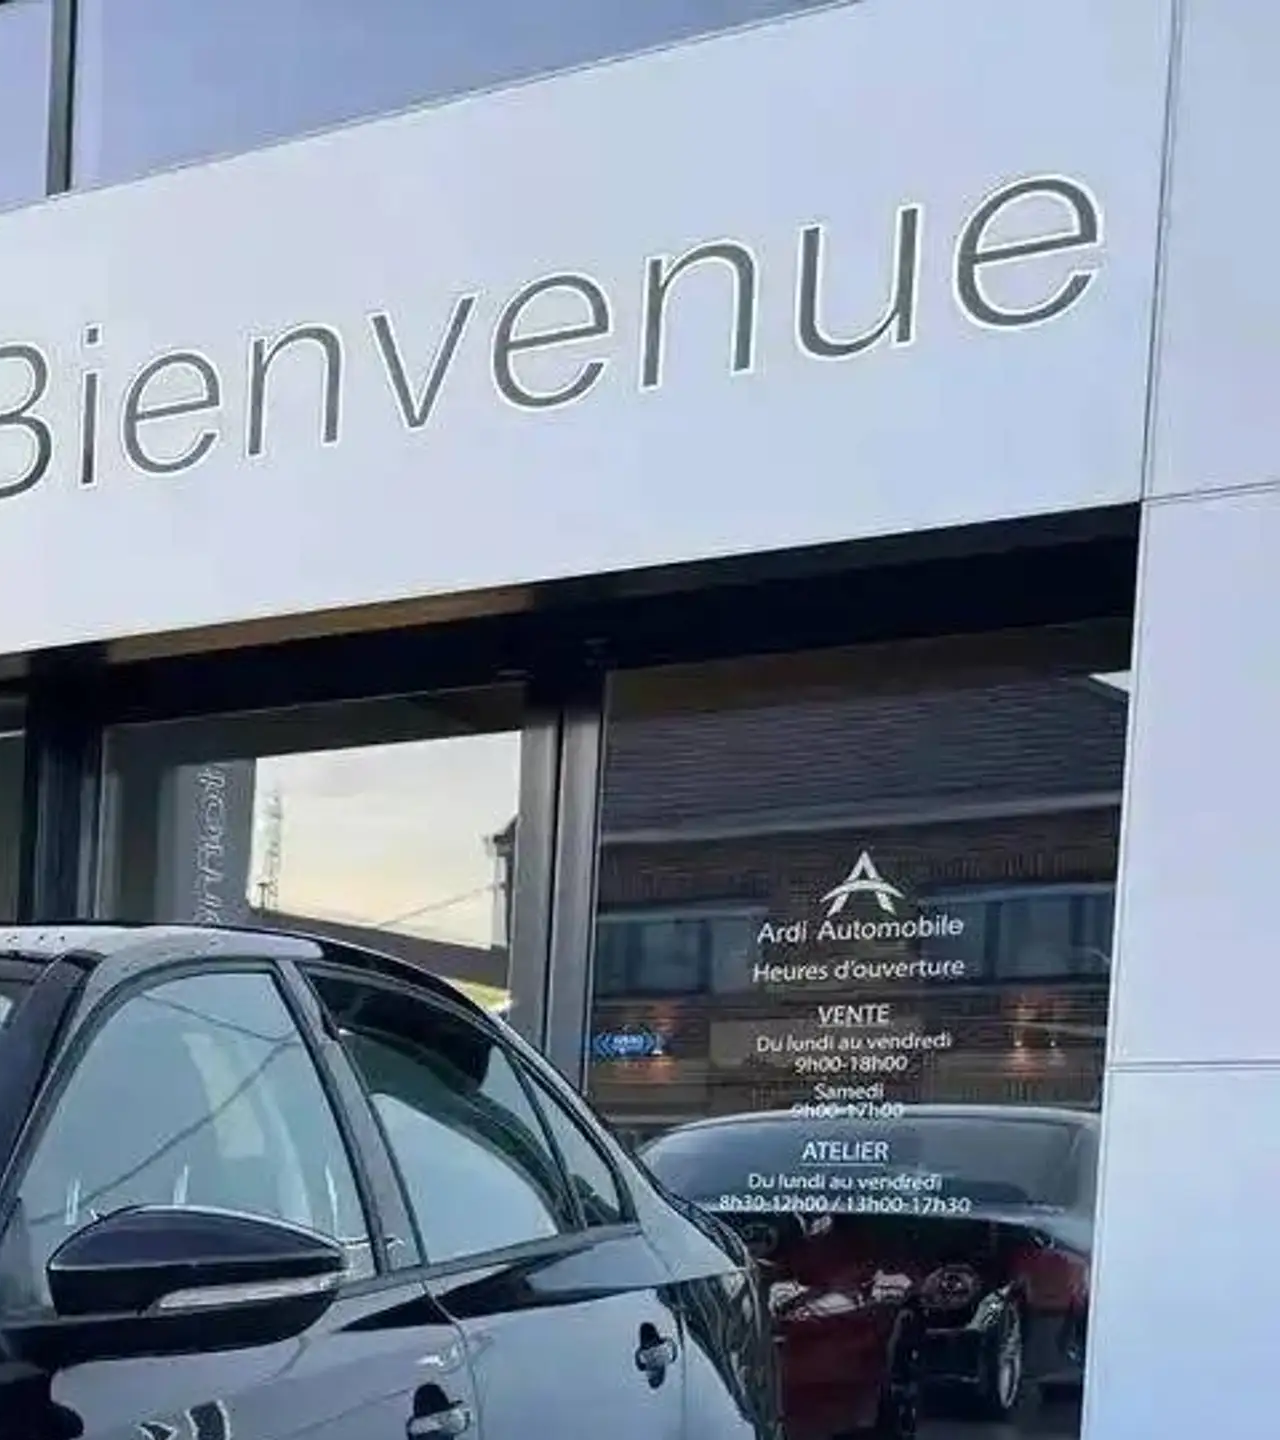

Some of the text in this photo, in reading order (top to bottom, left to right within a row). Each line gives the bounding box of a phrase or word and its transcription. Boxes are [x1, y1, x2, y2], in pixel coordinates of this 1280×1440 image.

[757, 914, 965, 943] Ardi Automobile
[752, 958, 966, 982] Heures d'ouverture
[817, 1004, 890, 1026] VENTE
[756, 1031, 952, 1052] Du lundi au vendredi
[793, 1055, 908, 1073] 9h00-18h00
[813, 1082, 885, 1100] Samedi
[801, 1141, 889, 1162] ATELIER
[748, 1172, 943, 1190] Du lundi au vendredi
[719, 1195, 828, 1212] 8h30-12h00
[847, 1197, 972, 1213] 13h00-17h30
